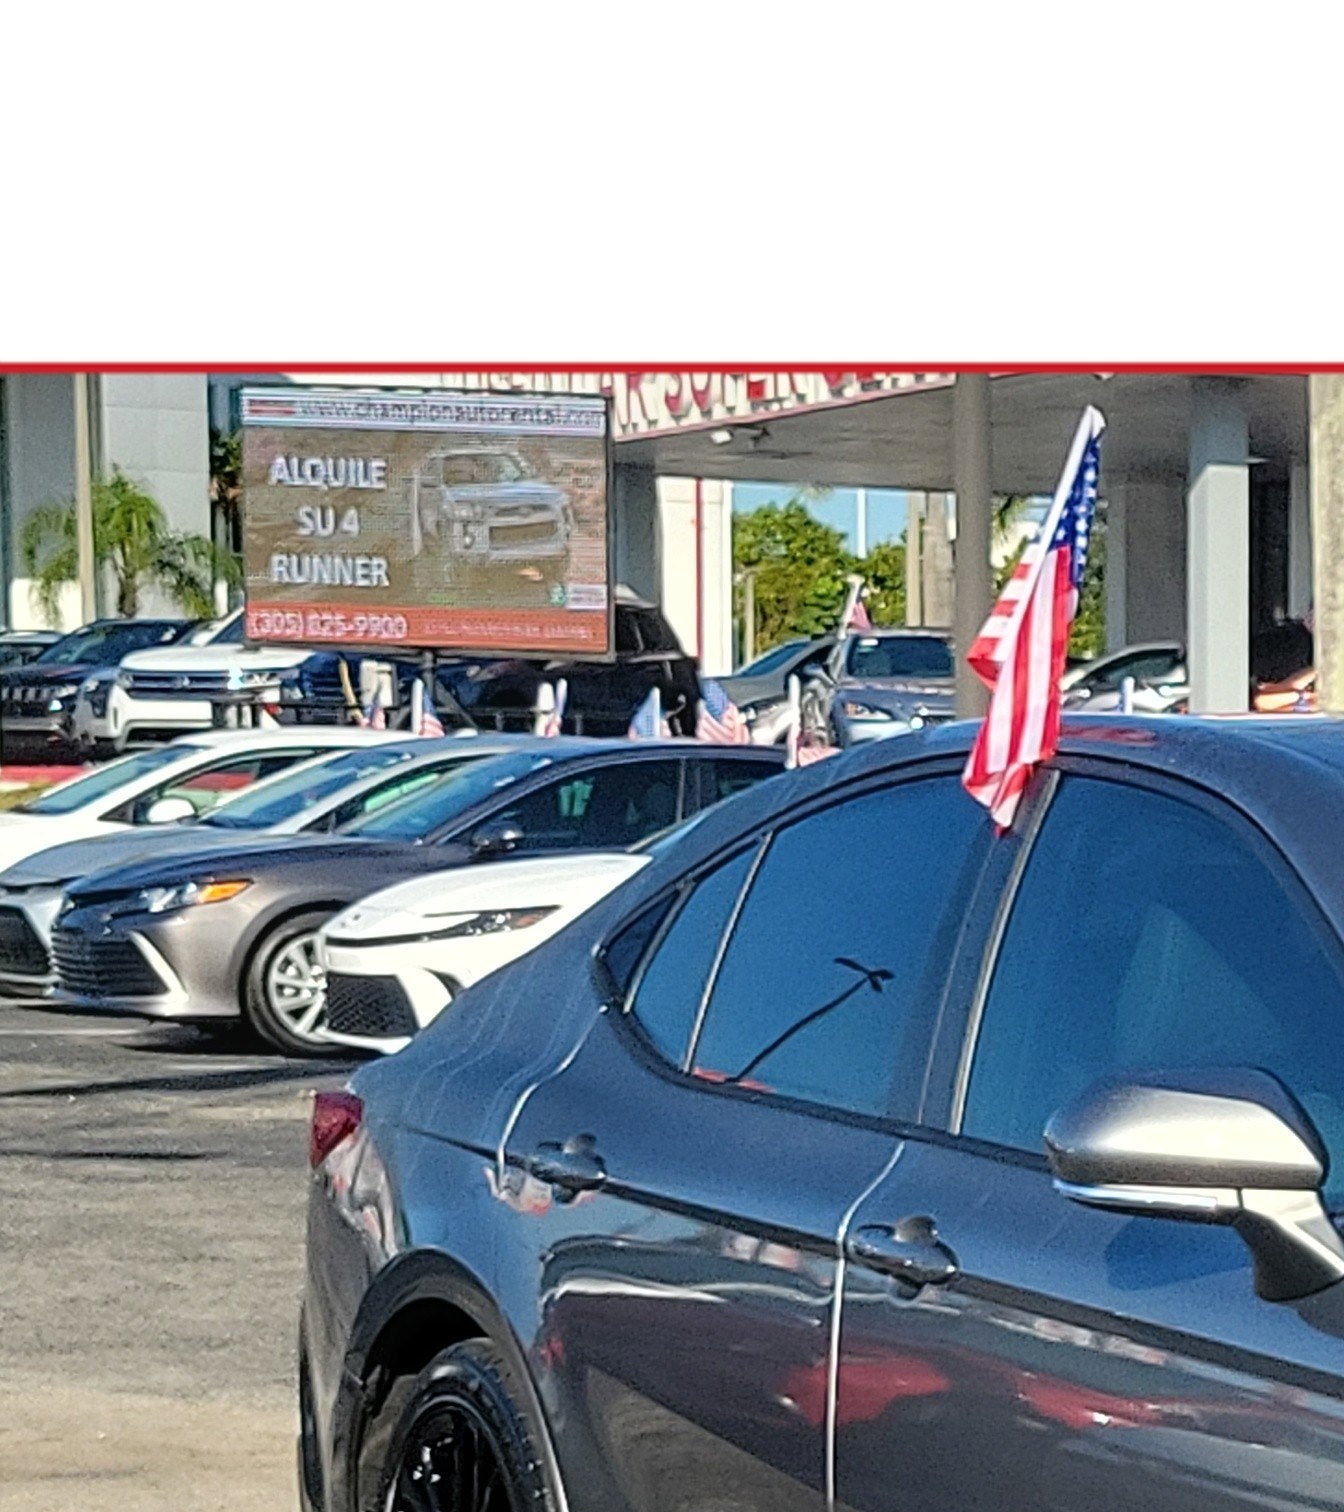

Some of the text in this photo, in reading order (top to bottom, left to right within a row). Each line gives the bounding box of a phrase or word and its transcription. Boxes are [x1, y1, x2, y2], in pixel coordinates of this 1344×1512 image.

[269, 456, 387, 490] ALQUILE
[297, 506, 361, 538] SU 4
[270, 553, 391, 588] RUNNER
